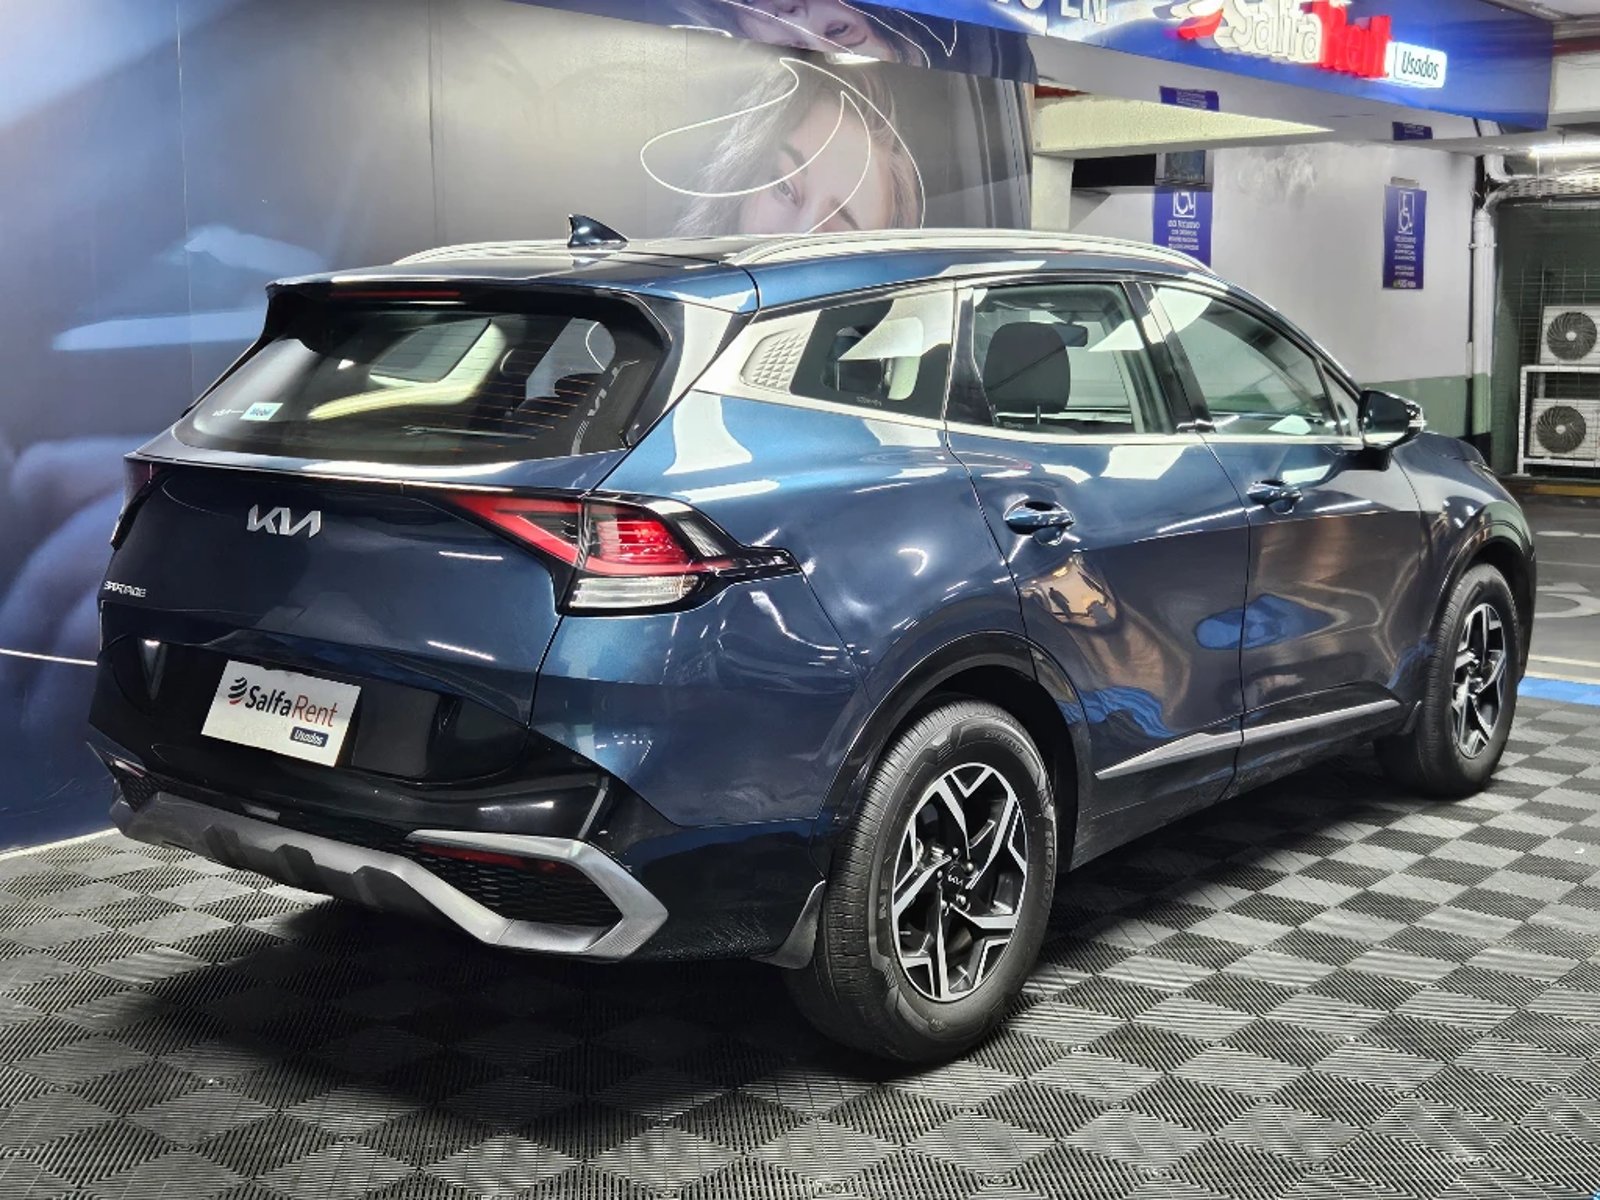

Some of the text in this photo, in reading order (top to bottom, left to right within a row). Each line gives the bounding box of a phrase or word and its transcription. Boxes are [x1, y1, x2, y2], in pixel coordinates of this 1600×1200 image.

[1401, 51, 1439, 80] Usados
[246, 504, 321, 538] KIA
[245, 685, 338, 728] SalfaRent
[294, 729, 324, 746] Usados
